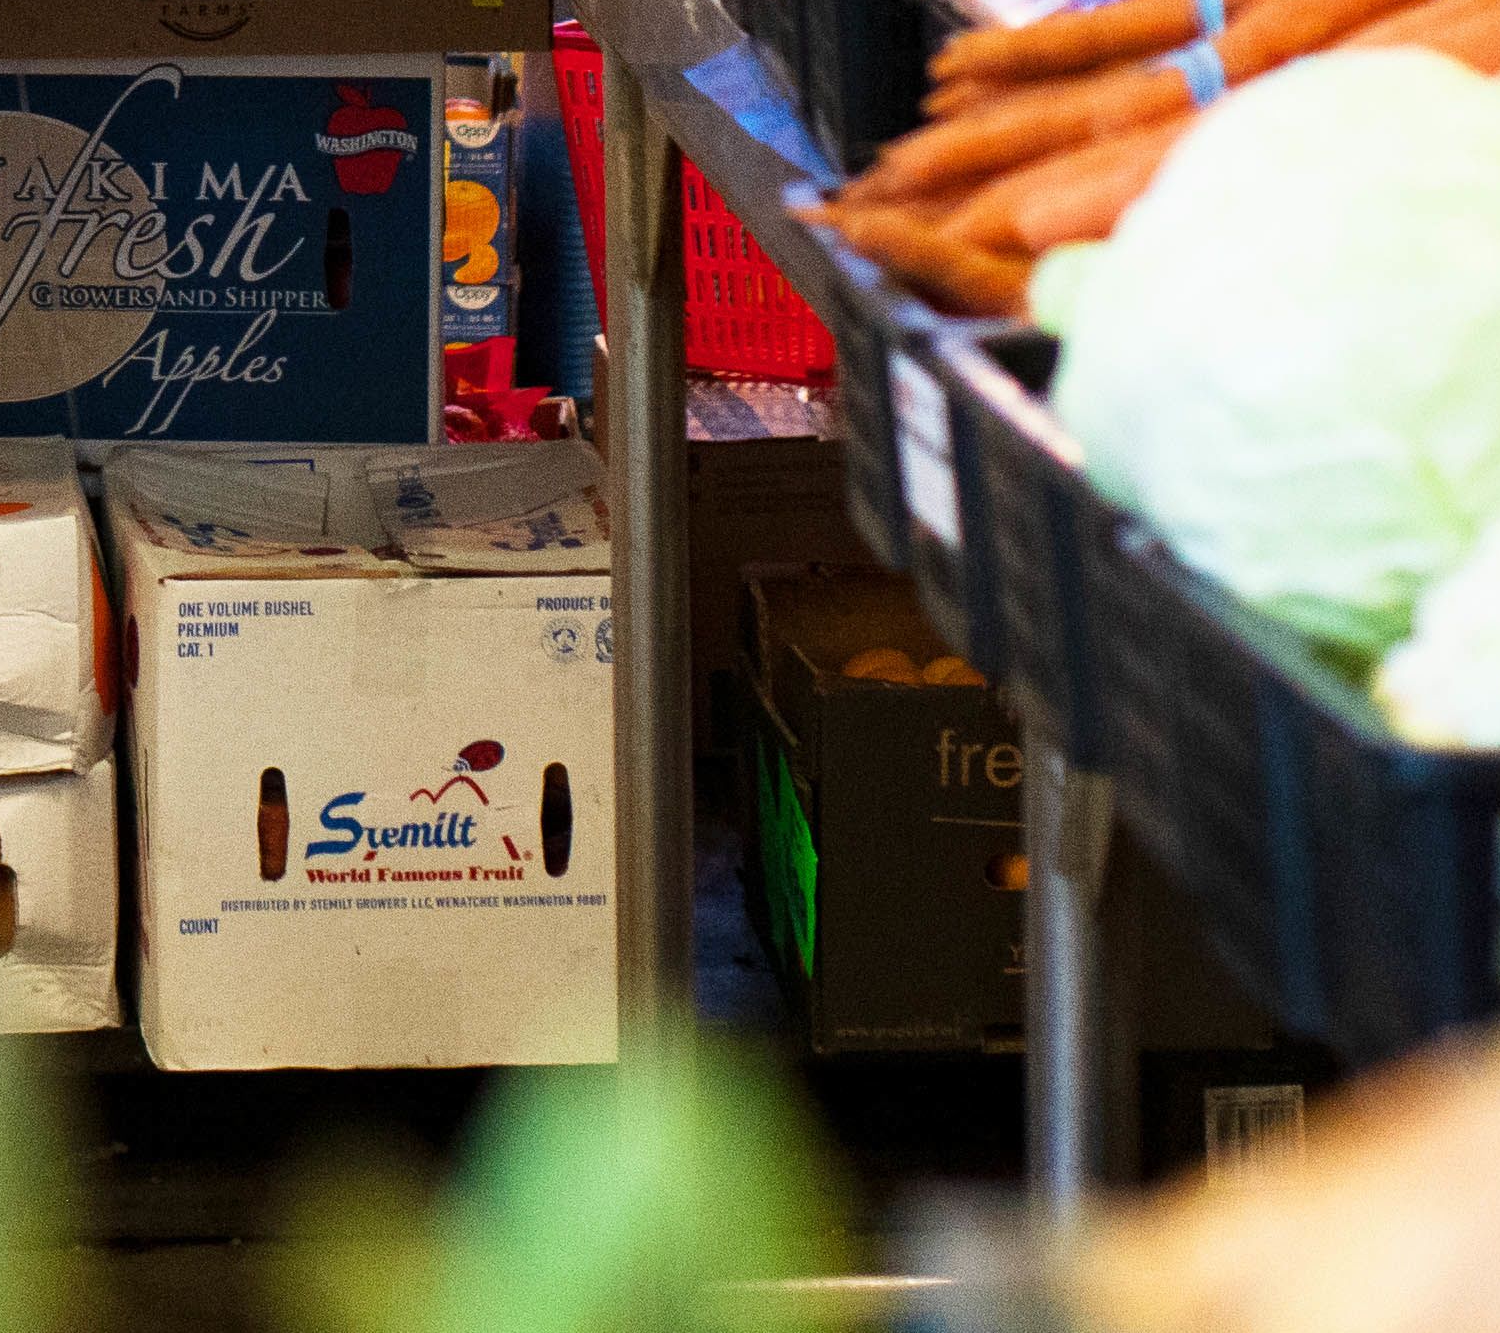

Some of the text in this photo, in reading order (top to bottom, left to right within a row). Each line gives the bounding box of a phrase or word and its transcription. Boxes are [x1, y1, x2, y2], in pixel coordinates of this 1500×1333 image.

[315, 130, 419, 156] WASHINGTON
[30, 285, 337, 310] GROWERS AND SHIPPER
[102, 308, 287, 435] Apples
[178, 599, 315, 618] ONE VOLUME BUSHEL
[536, 596, 612, 612] PRODUCE O
[177, 621, 240, 638] PREMIUM
[177, 642, 214, 658] CAT. 1
[936, 728, 1025, 788] fre
[305, 791, 478, 859] Stemilt
[305, 865, 526, 884] World Famous Fruit
[220, 899, 290, 912] DISTRIBUTED
[293, 898, 307, 911] BY
[310, 897, 353, 911] STEMILT
[355, 897, 408, 911] GROWERS
[435, 895, 500, 909] WENATCHEE
[502, 894, 573, 908] WASHINGTON
[178, 918, 220, 935] COUNT
